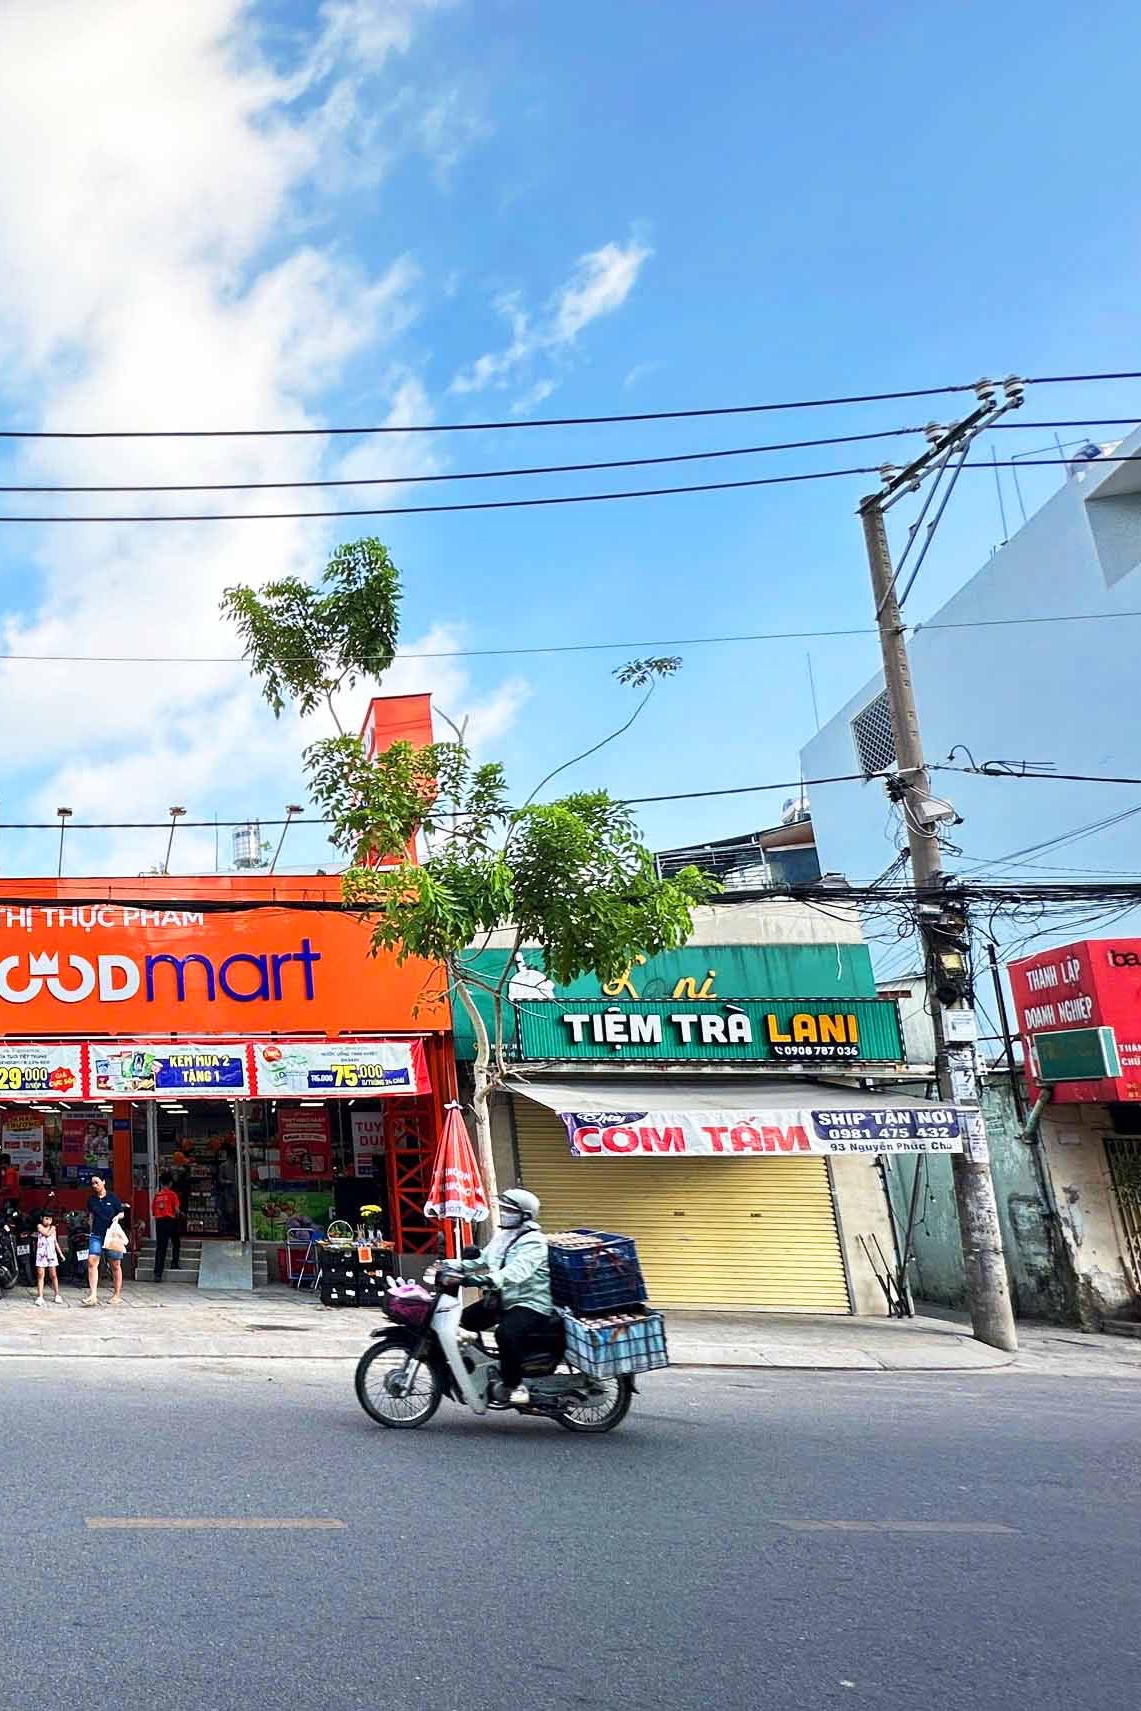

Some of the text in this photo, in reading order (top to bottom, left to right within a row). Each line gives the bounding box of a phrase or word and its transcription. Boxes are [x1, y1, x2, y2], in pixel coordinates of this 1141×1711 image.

[40, 904, 115, 932] THỰC
[1026, 955, 1081, 992] THÀNH LẬP
[1024, 992, 1092, 1030] DOANH NGHIỆP
[563, 1004, 859, 1050] TIỆM TRÀ LANI
[785, 1046, 858, 1055] 0908 787 036
[169, 1055, 230, 1067] KEM MUA 2
[213, 1070, 220, 1082] 1
[819, 1109, 954, 1126] SHIP TẬN NƠI
[701, 1117, 811, 1152] TẤM
[829, 1127, 949, 1139] 0981 475 432
[830, 1143, 845, 1151] 93
